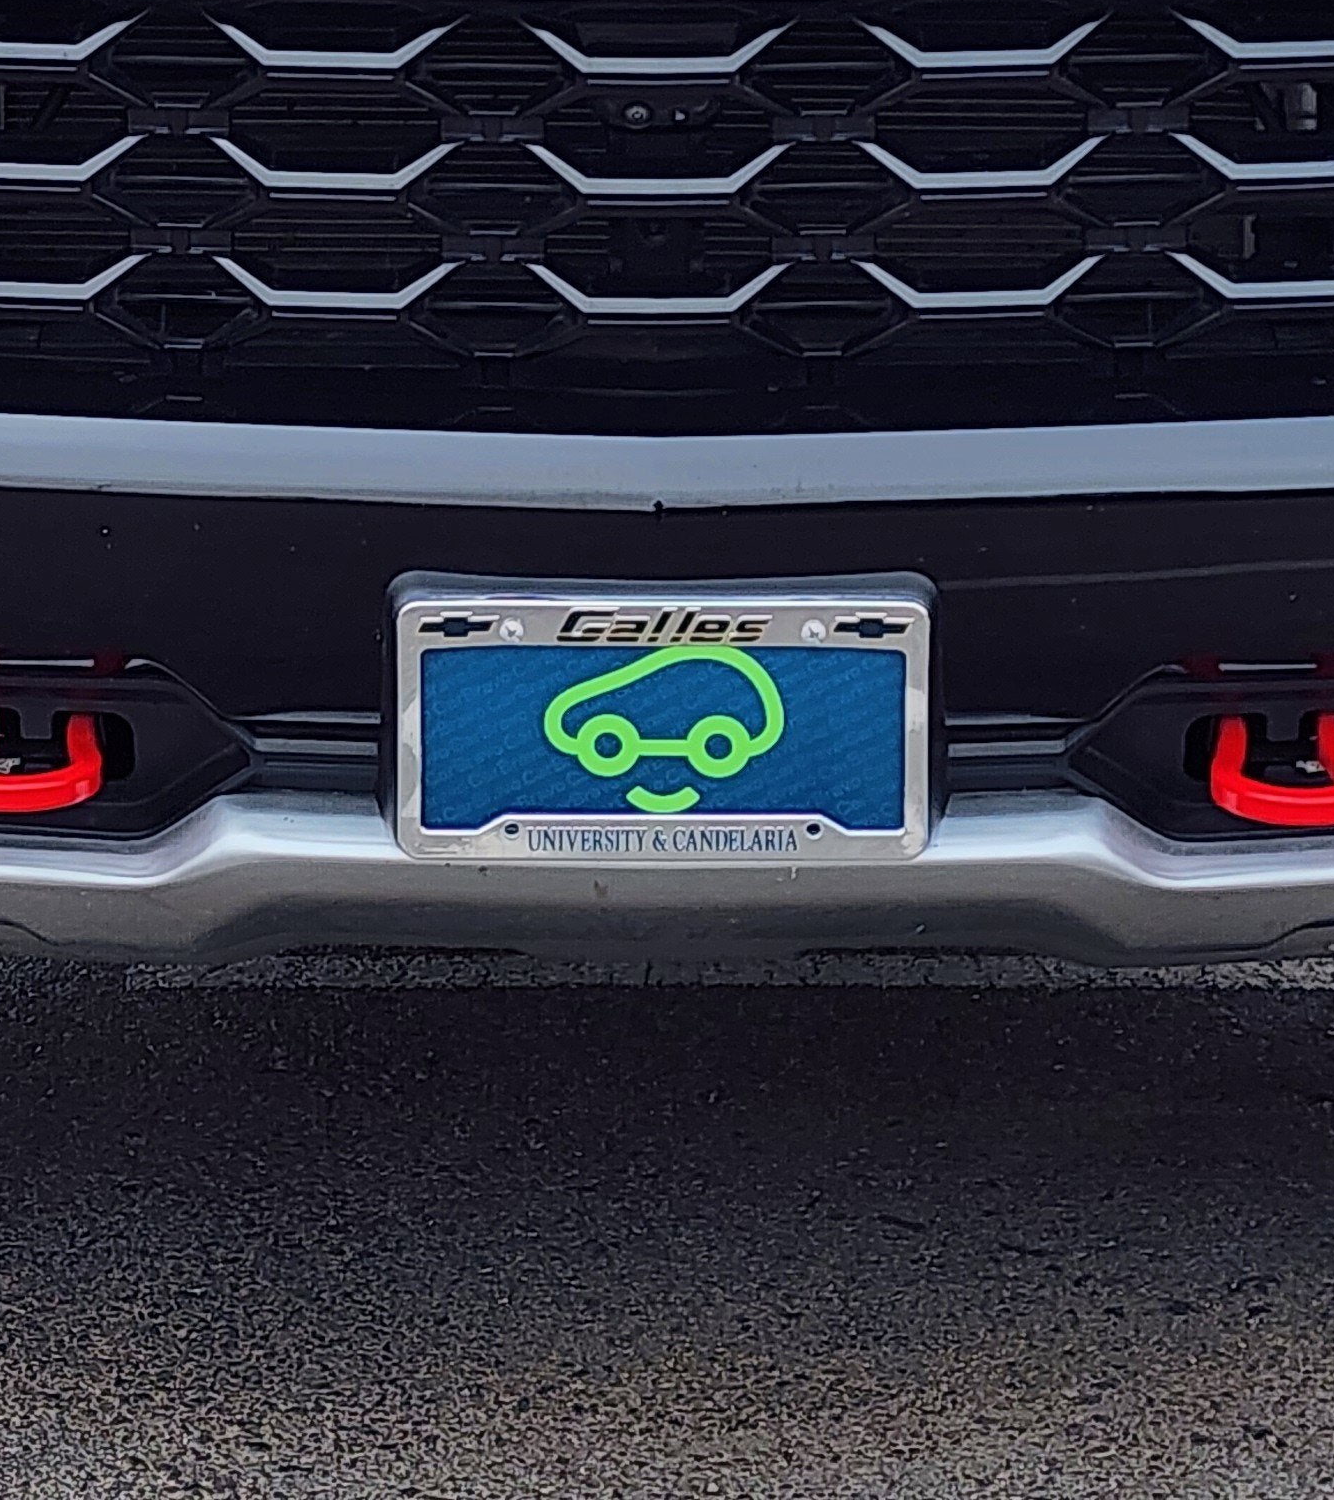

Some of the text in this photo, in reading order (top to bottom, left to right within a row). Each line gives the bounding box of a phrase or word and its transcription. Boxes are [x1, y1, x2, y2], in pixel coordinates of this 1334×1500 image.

[556, 606, 773, 643] Galles
[526, 826, 799, 852] UNIVERSITY & CANDELARIA
